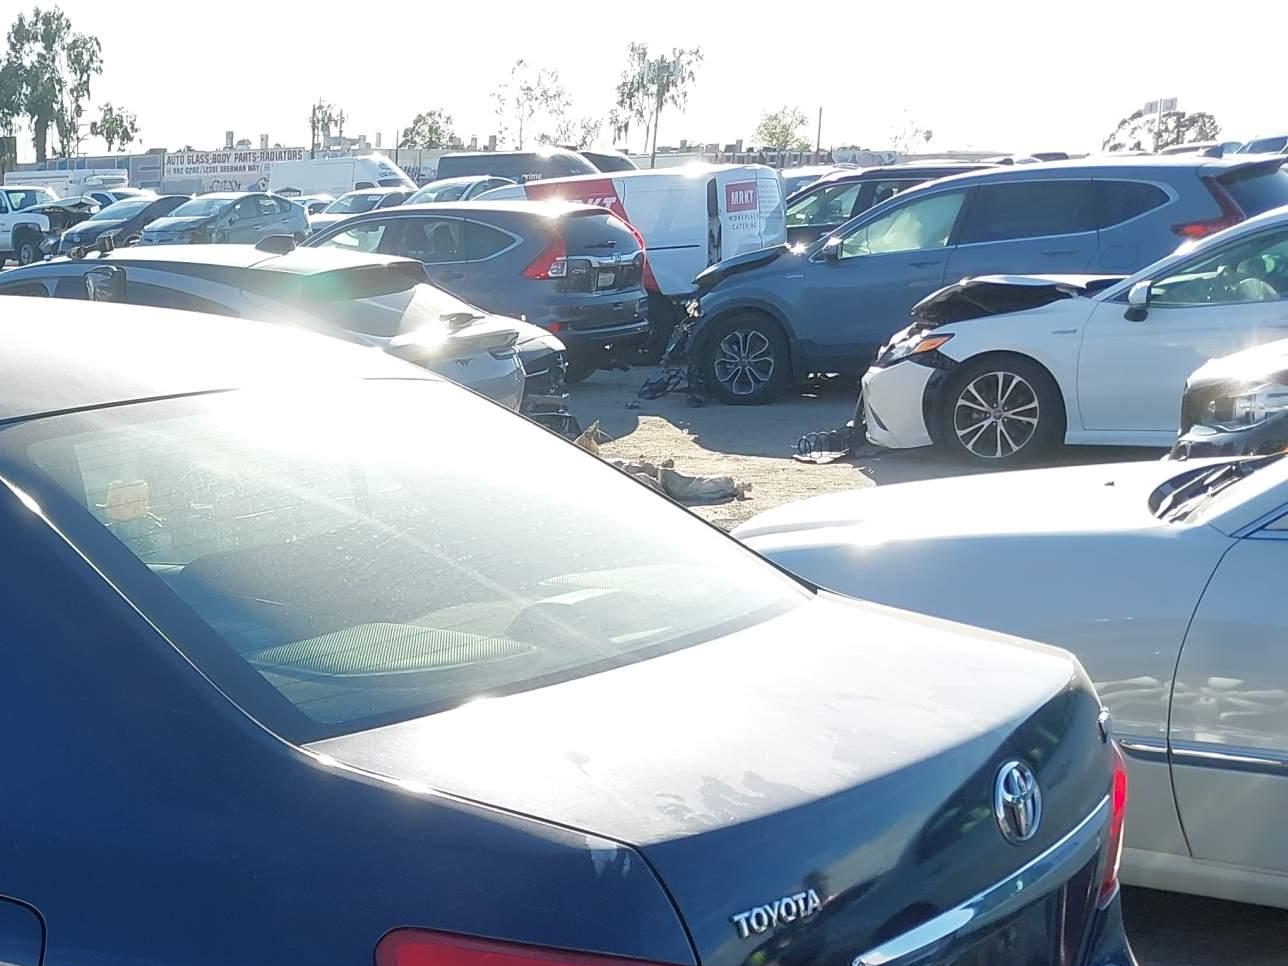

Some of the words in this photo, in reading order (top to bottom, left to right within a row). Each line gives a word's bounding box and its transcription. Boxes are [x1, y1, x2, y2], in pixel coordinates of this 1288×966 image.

[166, 154, 185, 166] AUTO
[220, 165, 246, 173] SHERMAN
[731, 190, 754, 205] MRKT
[733, 888, 823, 938] TOYOTA
